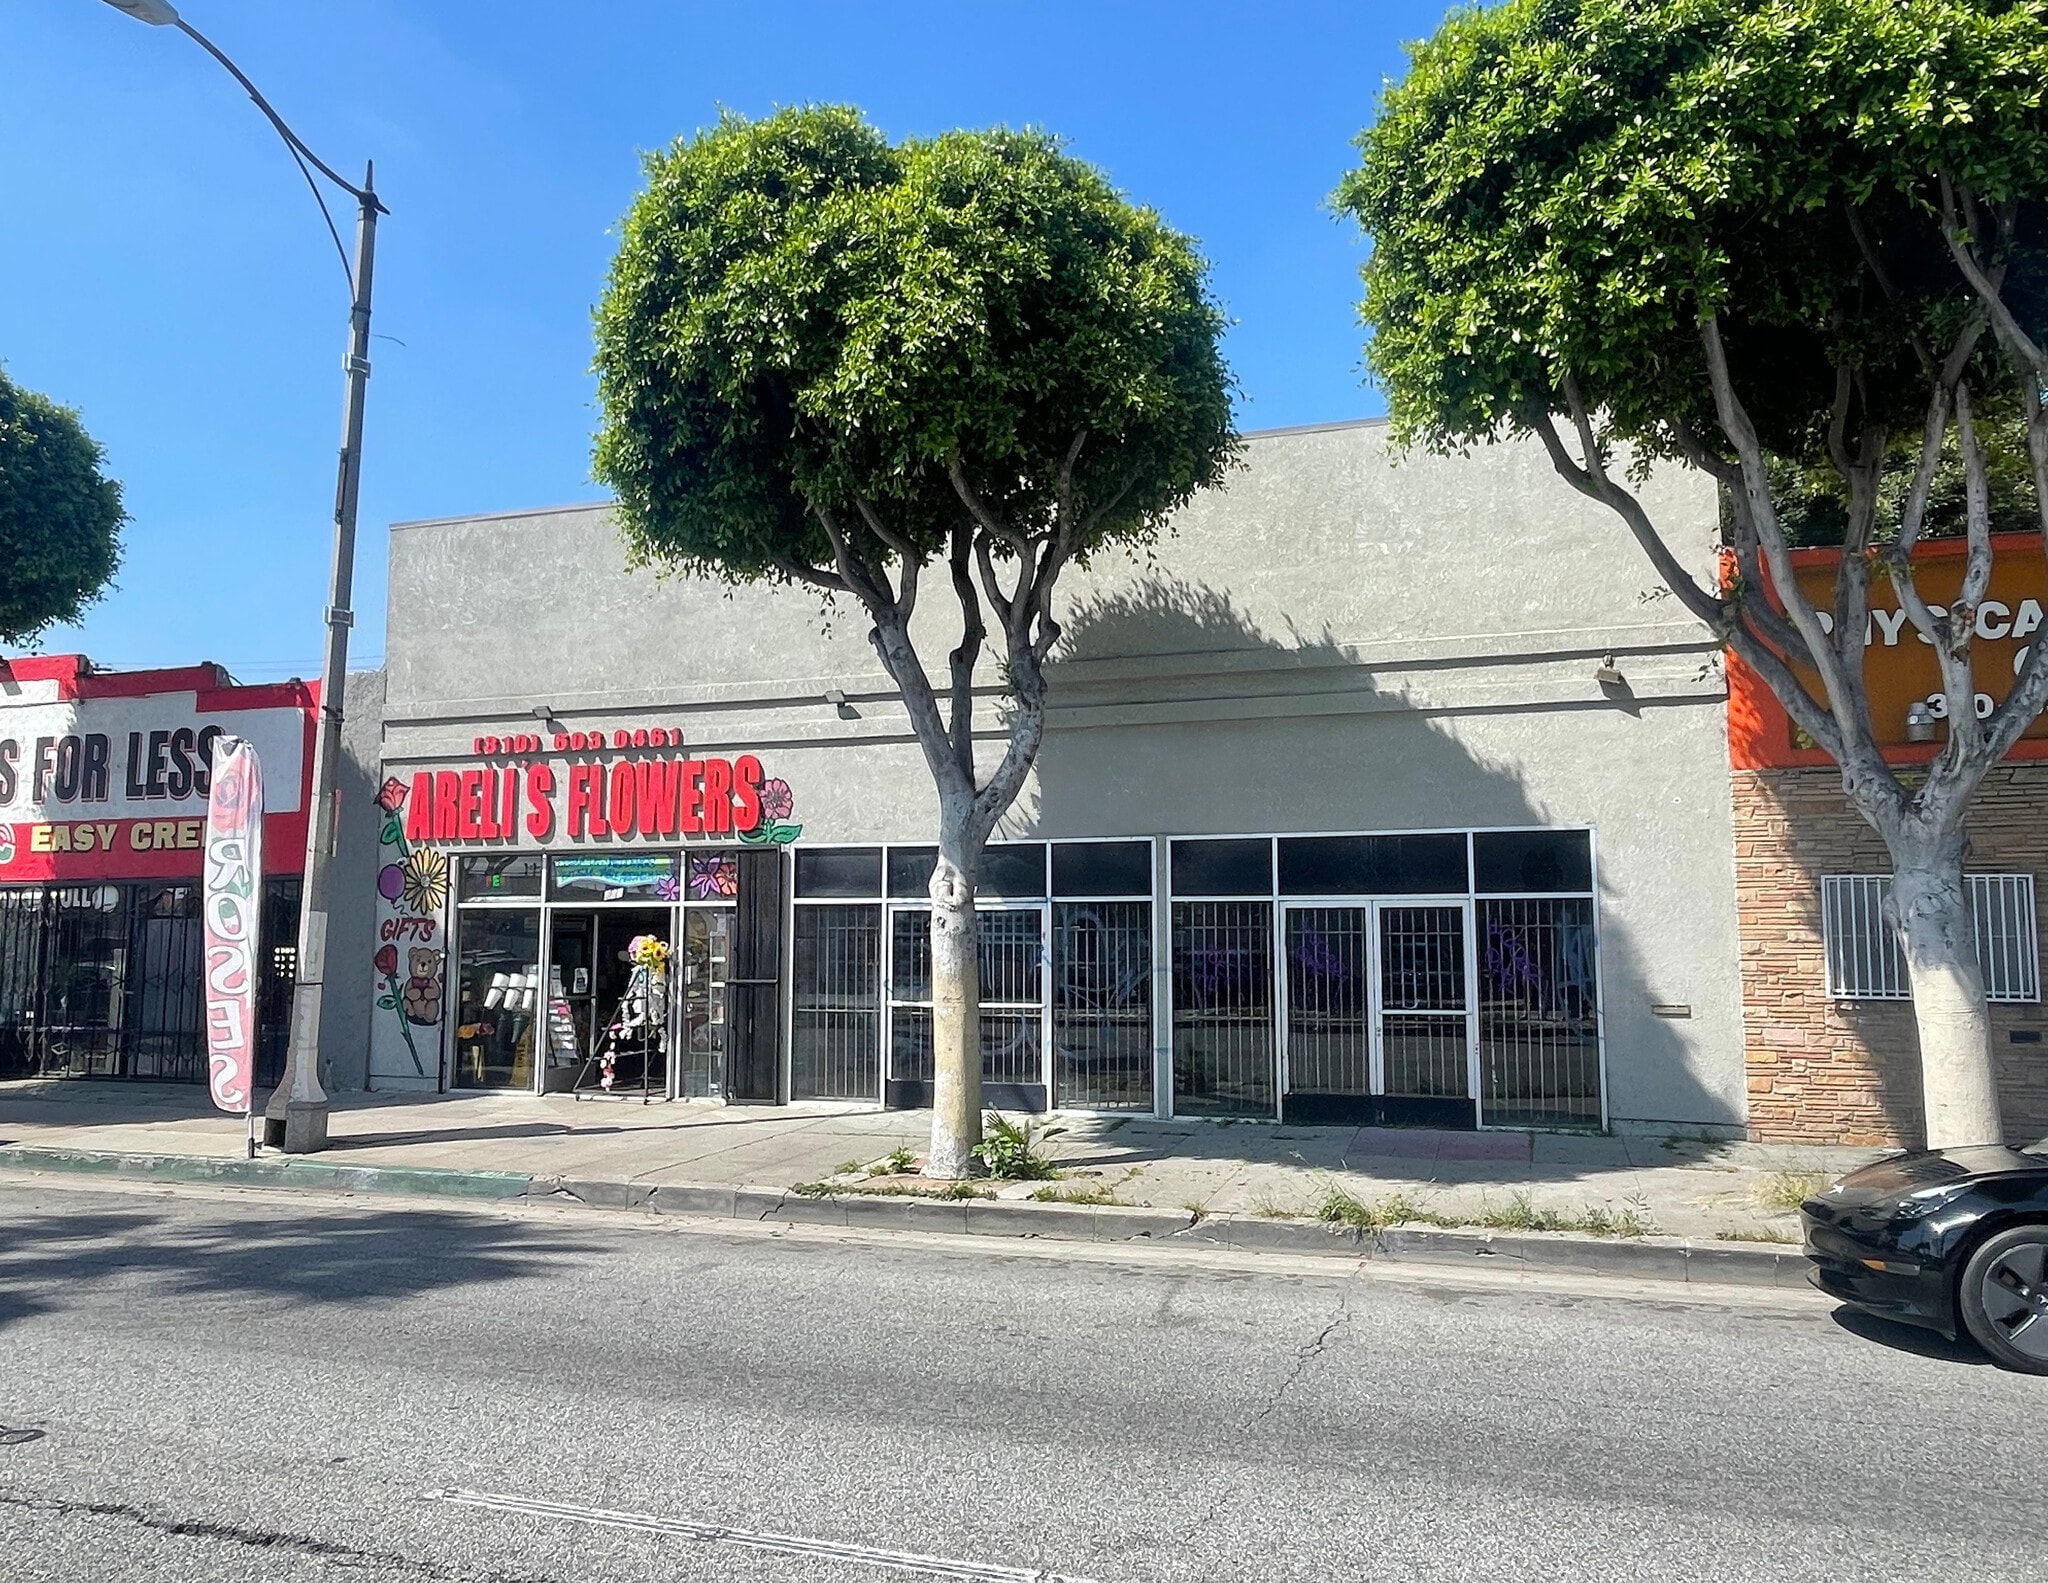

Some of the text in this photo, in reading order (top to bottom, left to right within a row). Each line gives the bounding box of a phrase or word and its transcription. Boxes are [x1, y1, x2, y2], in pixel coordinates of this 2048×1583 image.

[474, 727, 680, 755] (310) 603 0461
[33, 732, 110, 804] FOR
[405, 754, 761, 841] ARELI'S FLOWERS
[30, 821, 206, 852] EASY CRE
[380, 916, 436, 942] GIFTS
